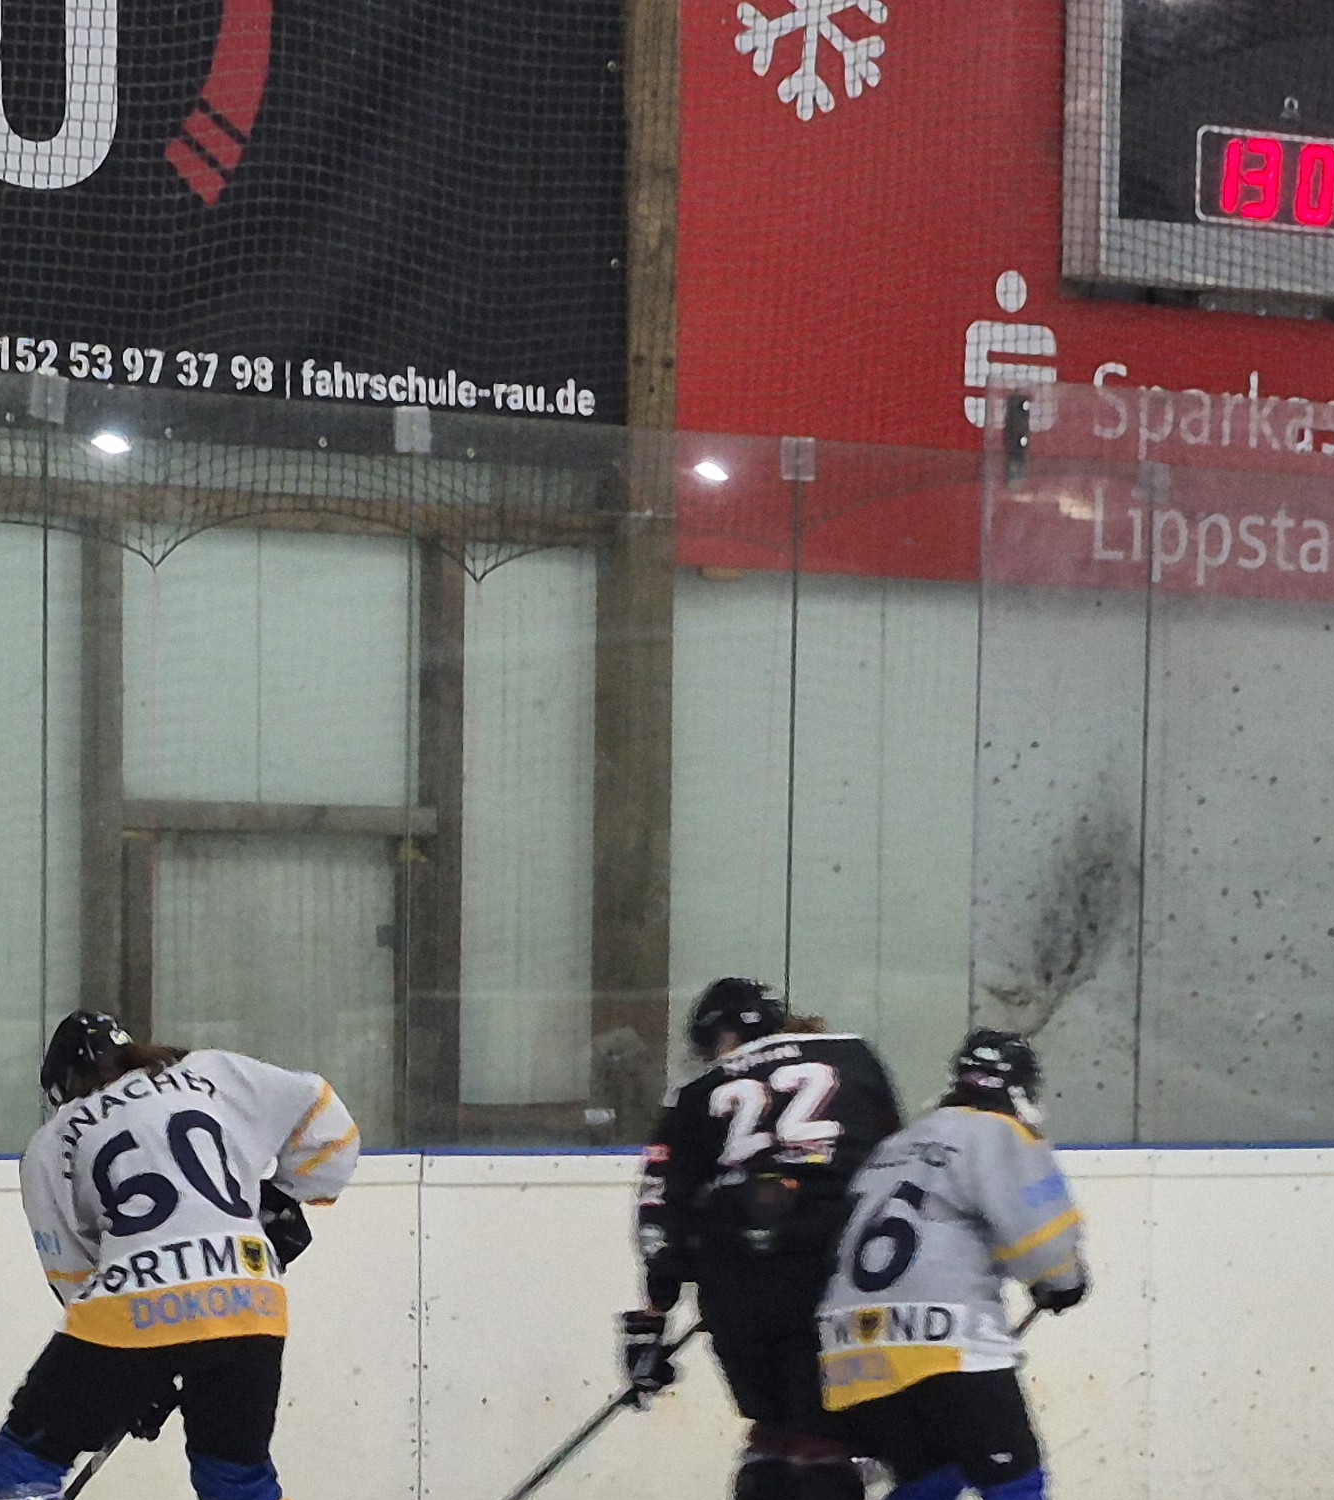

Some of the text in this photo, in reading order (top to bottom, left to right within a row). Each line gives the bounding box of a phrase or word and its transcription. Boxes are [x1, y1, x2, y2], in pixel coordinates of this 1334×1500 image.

[69, 341, 113, 381] 53
[122, 347, 166, 384] 97
[175, 350, 219, 388] 37
[230, 354, 274, 393] 98
[301, 360, 596, 417] fahrschule-rau.de
[708, 1061, 841, 1167] 22
[91, 1109, 253, 1237] 60
